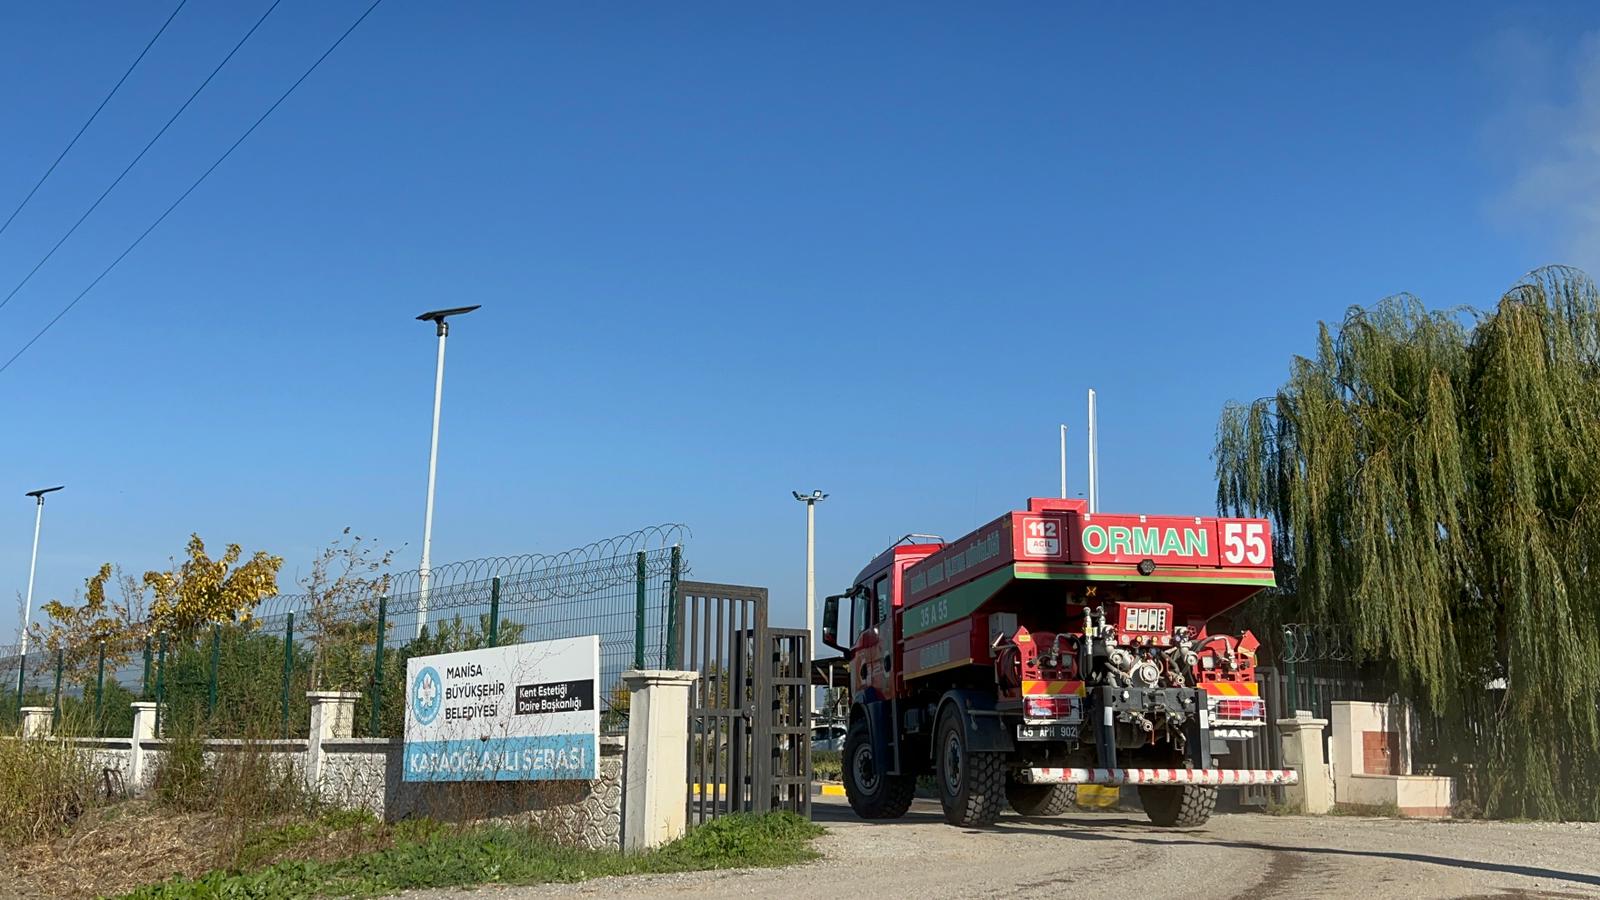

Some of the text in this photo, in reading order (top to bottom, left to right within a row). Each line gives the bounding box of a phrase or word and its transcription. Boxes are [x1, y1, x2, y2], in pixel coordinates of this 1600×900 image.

[1028, 521, 1056, 537] 112
[1082, 525, 1209, 557] ORMAN
[1225, 523, 1266, 564] 55
[931, 604, 937, 624] A
[446, 662, 483, 679] MANİSA
[445, 680, 505, 701] BÜYÜKŞEHİR
[519, 684, 568, 698] Kent Estetiği
[445, 701, 498, 720] BELEDİYESİ
[519, 697, 582, 713] Daire Başkanlığı
[1022, 726, 1076, 737] 45 APH 902
[1214, 729, 1254, 738] MAN
[410, 745, 585, 773] KARAOĞLANLI SERASI
